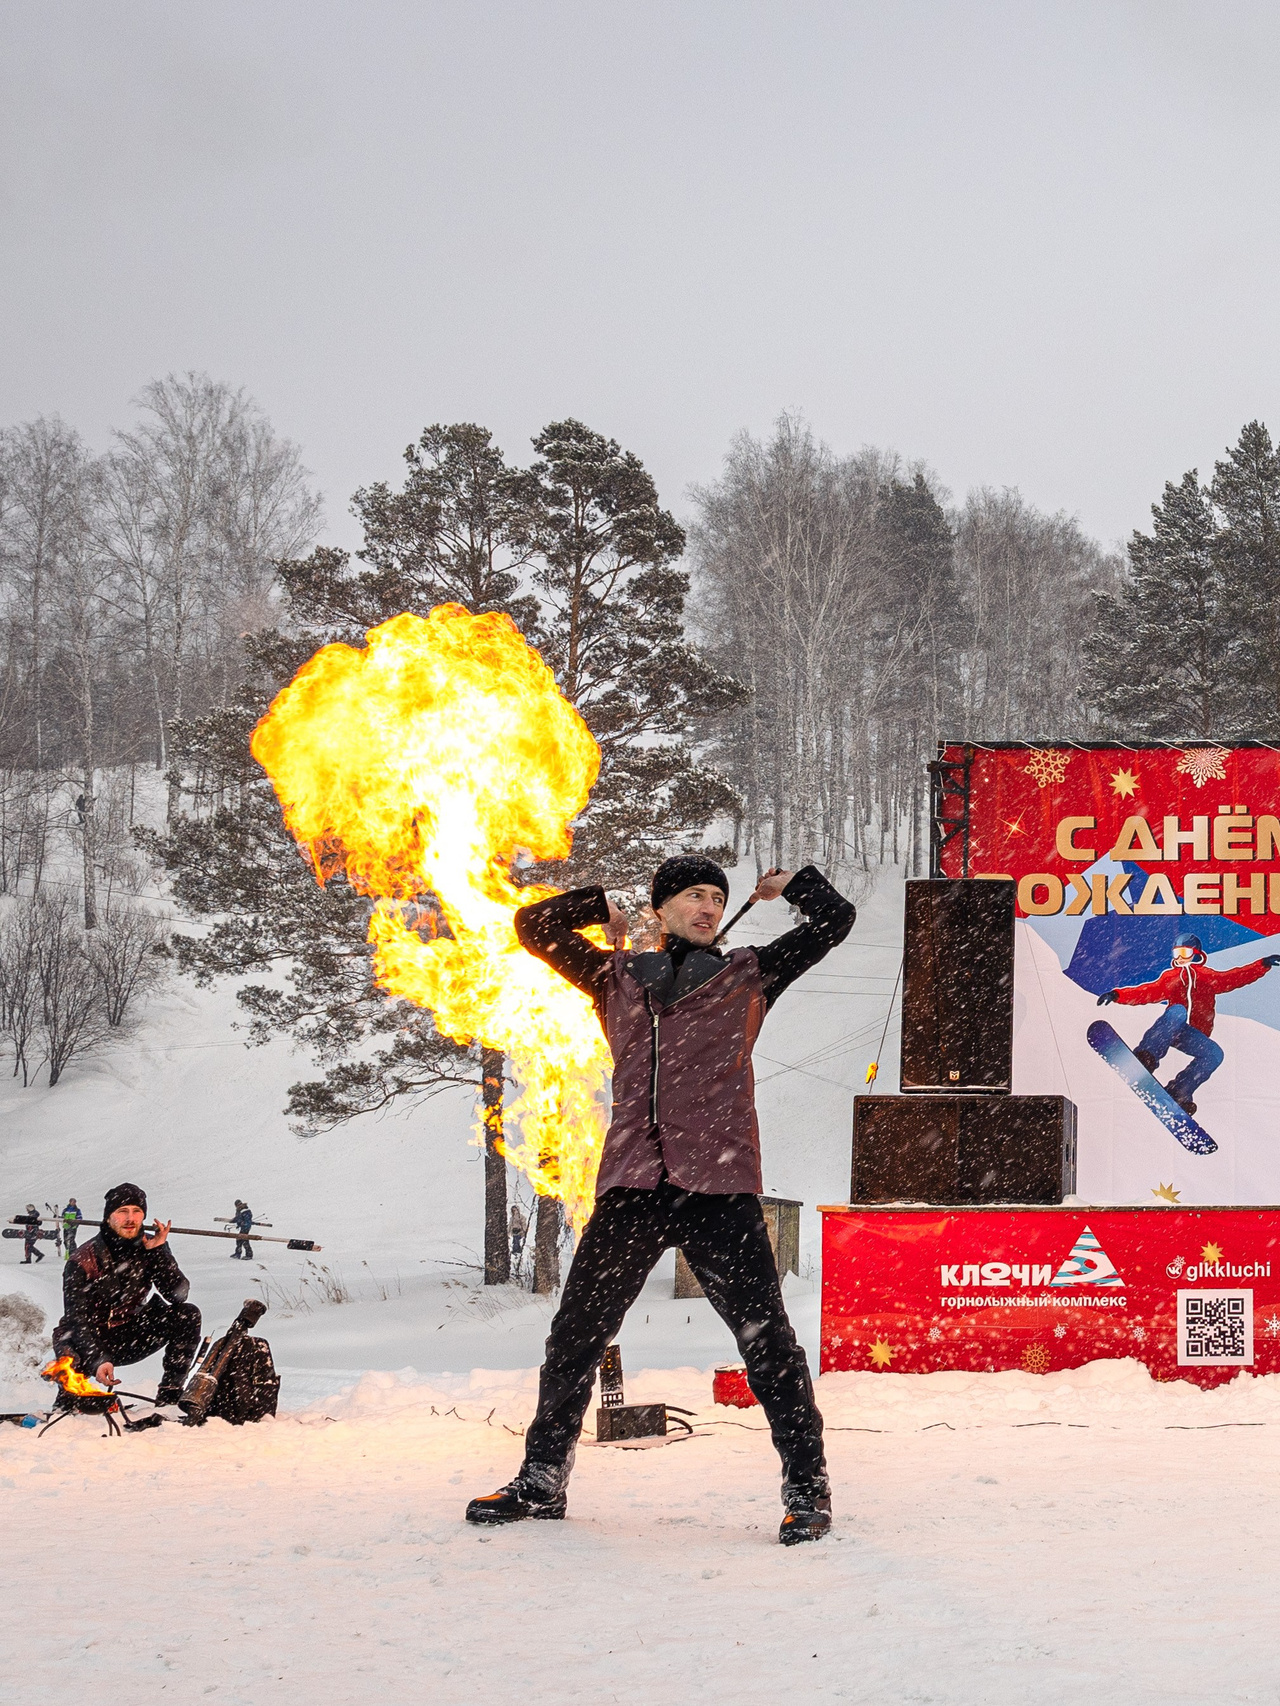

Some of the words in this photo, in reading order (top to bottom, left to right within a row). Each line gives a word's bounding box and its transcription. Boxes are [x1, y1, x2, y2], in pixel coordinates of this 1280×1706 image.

[1056, 815, 1096, 861] С
[940, 1261, 1052, 1287] КЛЮЧИ
[1186, 1261, 1271, 1282] glkkluchi
[940, 1292, 1048, 1310] горнолыжный
[1052, 1295, 1127, 1307] комплекс
